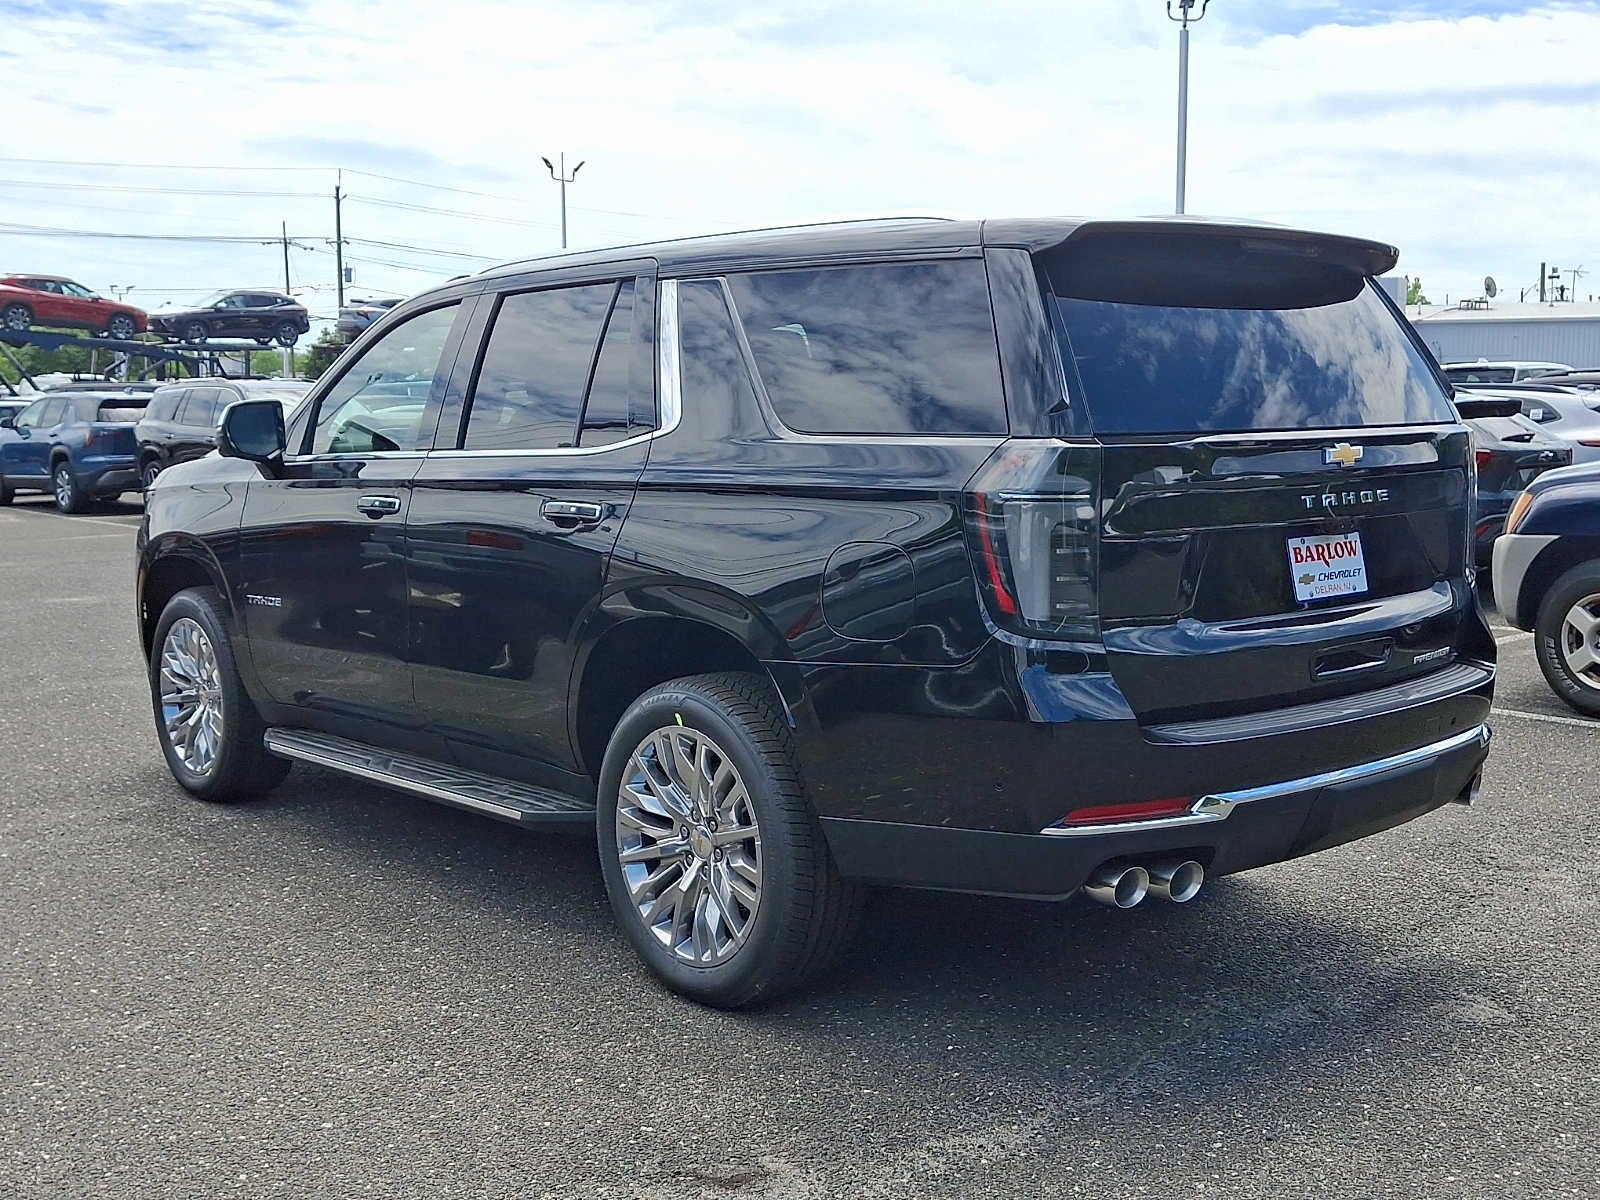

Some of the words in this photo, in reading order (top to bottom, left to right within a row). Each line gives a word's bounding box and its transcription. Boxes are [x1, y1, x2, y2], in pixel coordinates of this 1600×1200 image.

[1301, 488, 1390, 509] TAHOE
[1292, 539, 1358, 568] BARLOW
[1317, 567, 1362, 582] CHEVROLET
[246, 594, 282, 607] TAHOE
